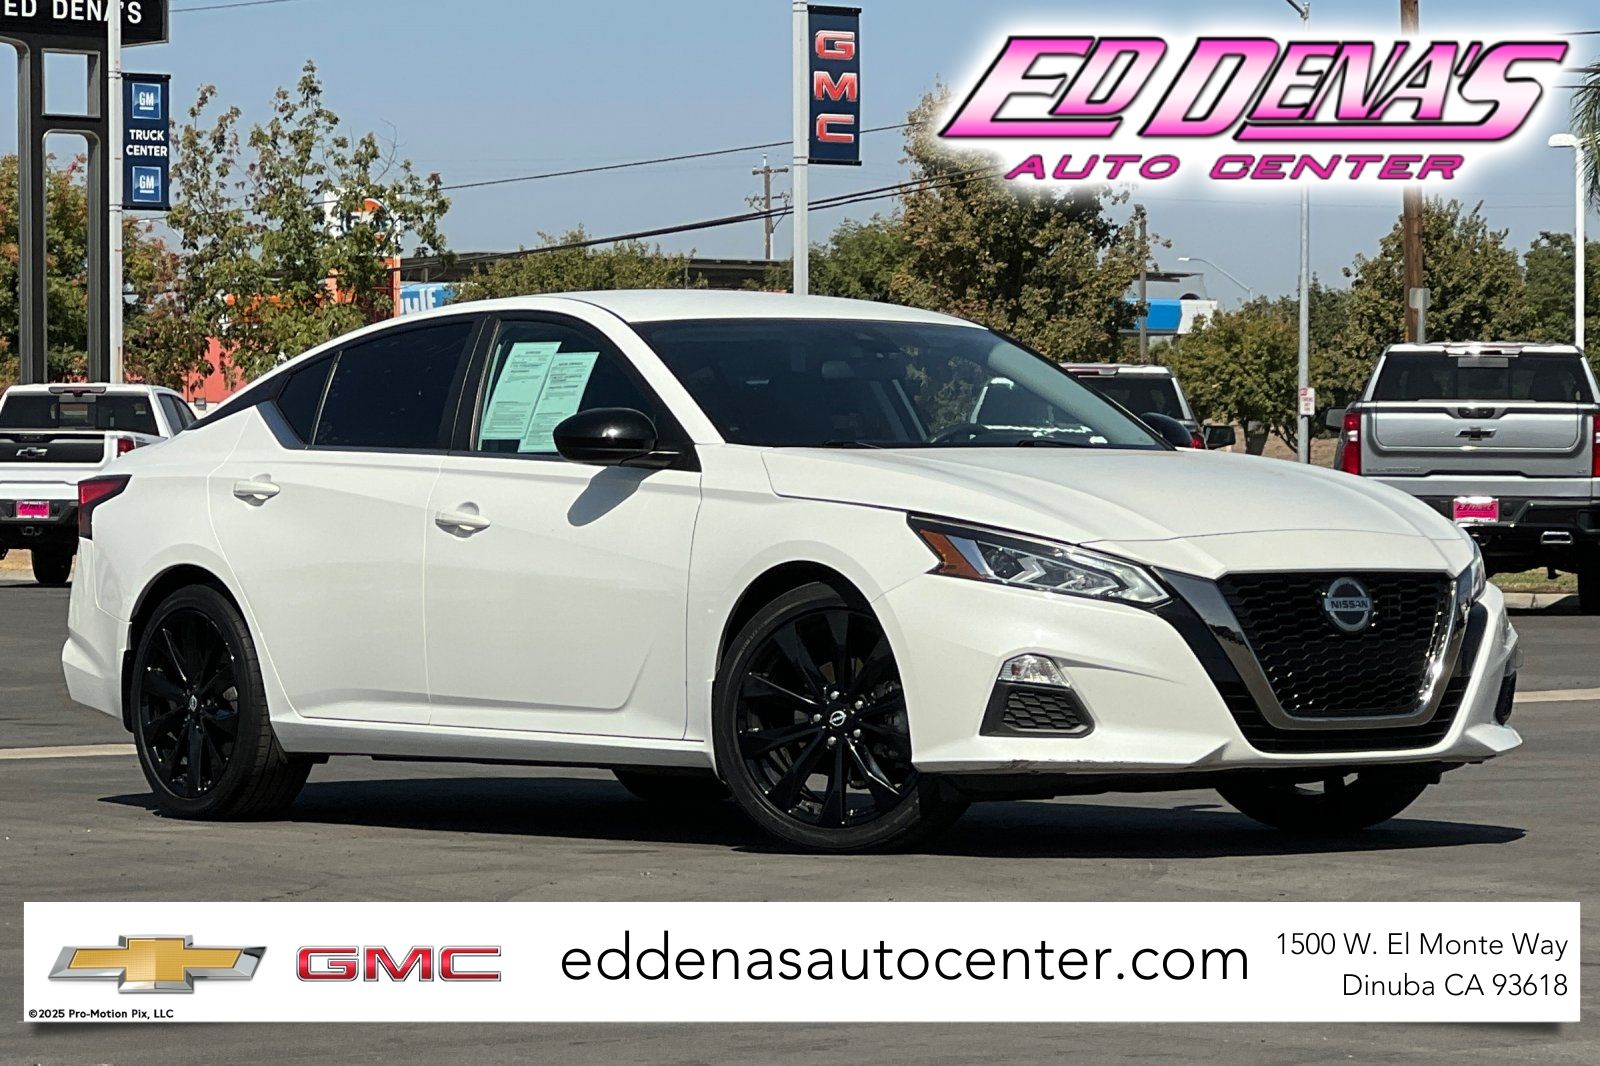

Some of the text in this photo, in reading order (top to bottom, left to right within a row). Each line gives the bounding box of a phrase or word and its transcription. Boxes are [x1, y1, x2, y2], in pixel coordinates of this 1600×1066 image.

[4, 0, 37, 17] ED
[814, 30, 858, 143] GMC
[139, 92, 154, 106] GM
[129, 129, 165, 141] TRUCK
[126, 144, 168, 157] CENTER
[139, 175, 155, 189] GM
[1330, 600, 1368, 609] NISSAN
